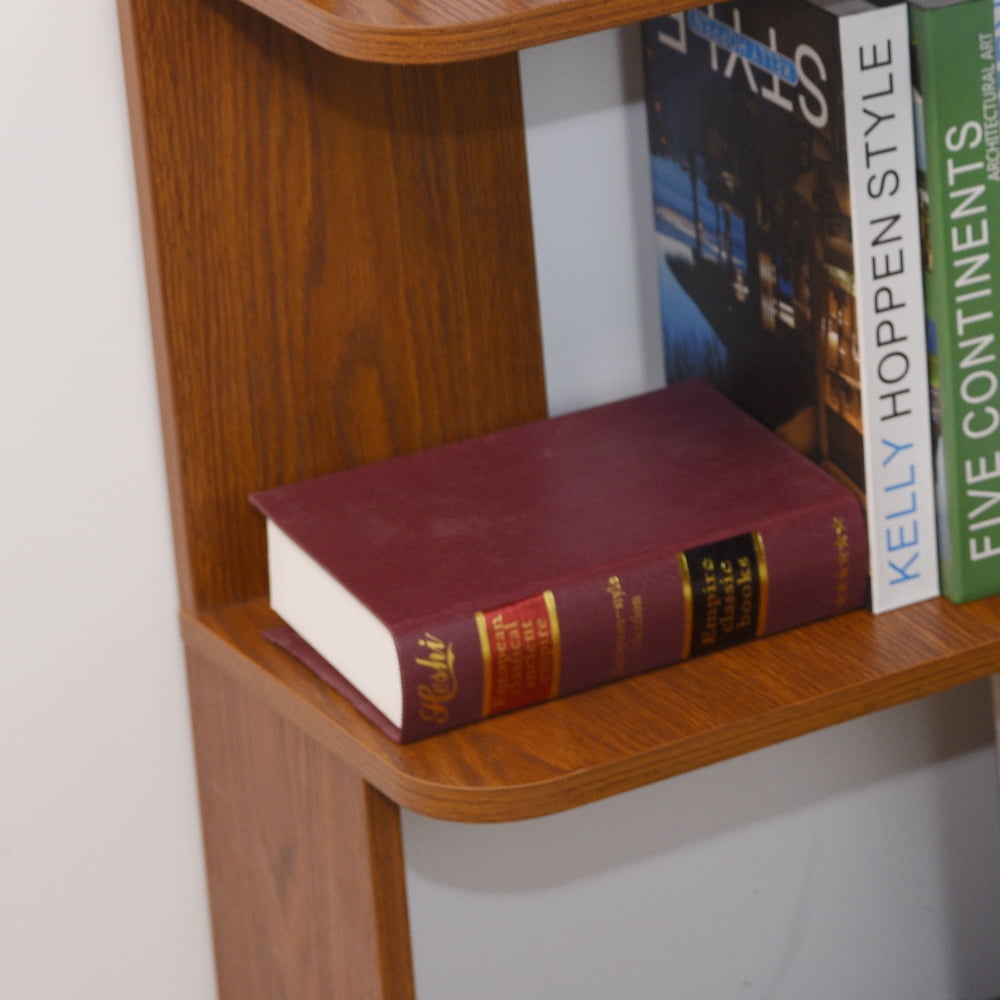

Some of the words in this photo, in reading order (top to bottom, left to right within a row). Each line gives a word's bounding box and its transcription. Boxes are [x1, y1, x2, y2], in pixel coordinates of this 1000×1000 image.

[979, 32, 994, 59] ART
[859, 39, 898, 200] STYLE
[870, 213, 912, 422] HOPPEN
[945, 120, 1000, 440] CONTINENTS
[881, 438, 921, 586] KELLY
[701, 557, 721, 645] Empire
[719, 560, 735, 634] classic
[736, 556, 752, 628] books
[415, 632, 459, 725] Heshi
